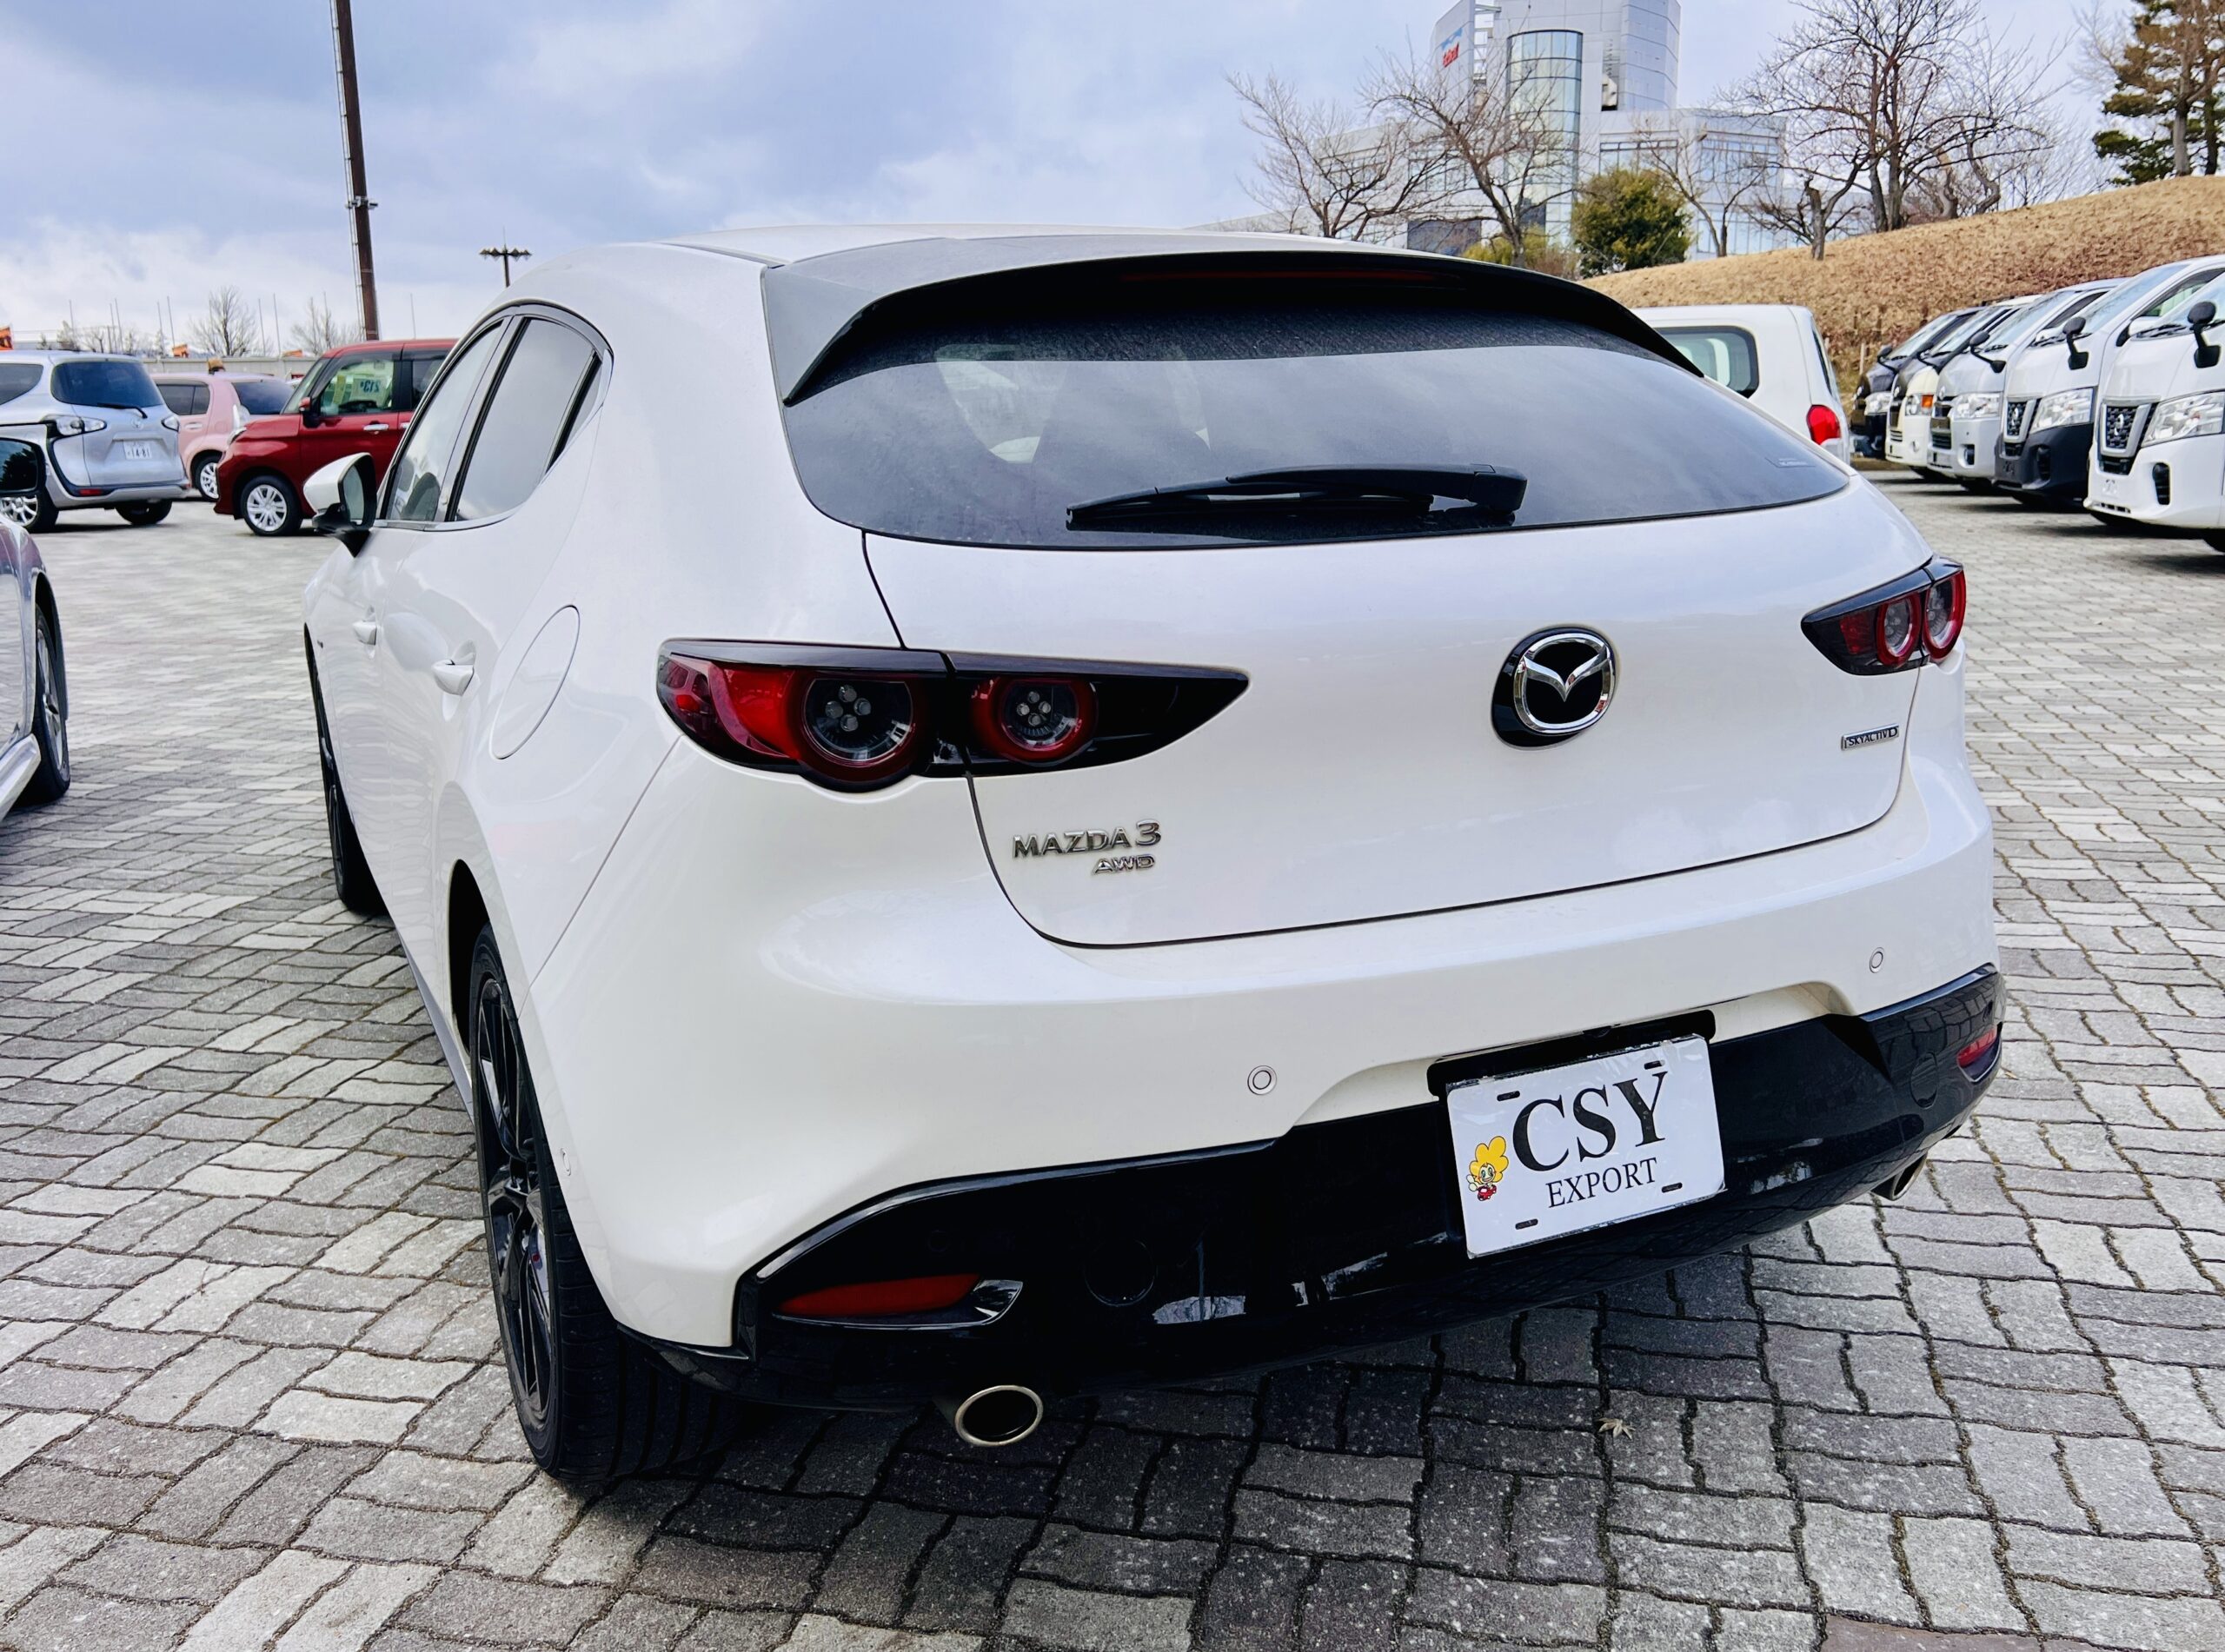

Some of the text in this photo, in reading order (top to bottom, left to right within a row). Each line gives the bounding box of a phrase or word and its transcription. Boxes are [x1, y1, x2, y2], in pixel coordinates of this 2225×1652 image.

[1093, 853, 1155, 874] AWD
[1512, 1071, 1669, 1171] CSY
[1545, 1157, 1657, 1209] EXPORT
